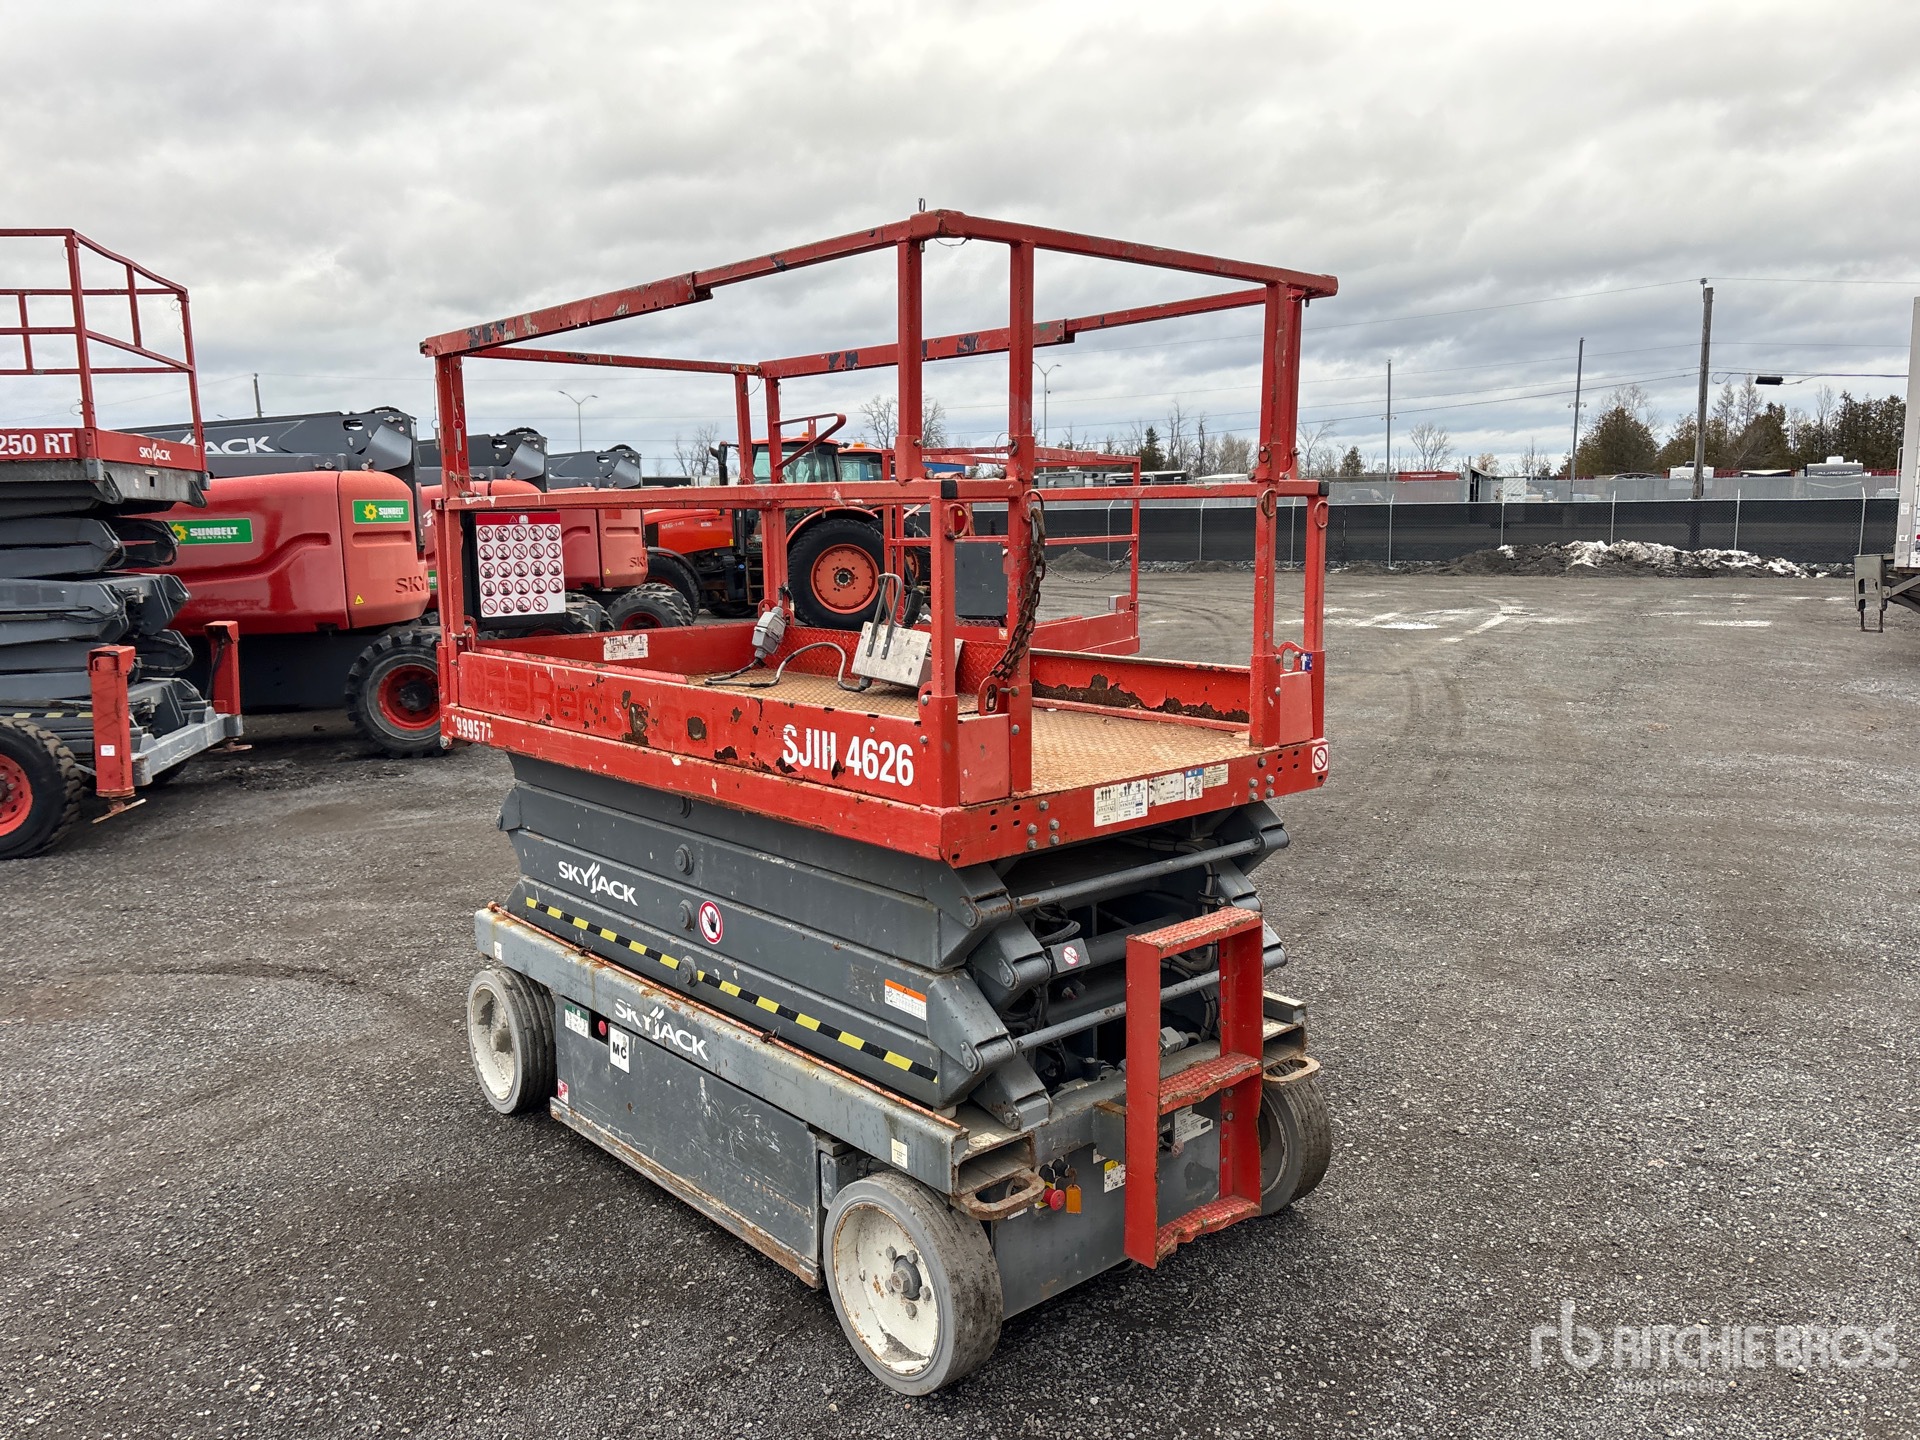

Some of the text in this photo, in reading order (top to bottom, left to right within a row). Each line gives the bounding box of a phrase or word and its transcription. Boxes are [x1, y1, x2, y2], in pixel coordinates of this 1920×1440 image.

[44, 433, 73, 454] RT
[139, 442, 171, 461] SKYJACK
[378, 507, 404, 515] SUNBELT
[190, 526, 238, 536] SUNBELT
[456, 716, 491, 741] 999577
[845, 735, 914, 787] 4626
[558, 861, 638, 907] SKYJACK
[614, 998, 709, 1062] SKYJACK
[612, 1041, 627, 1060] MC
